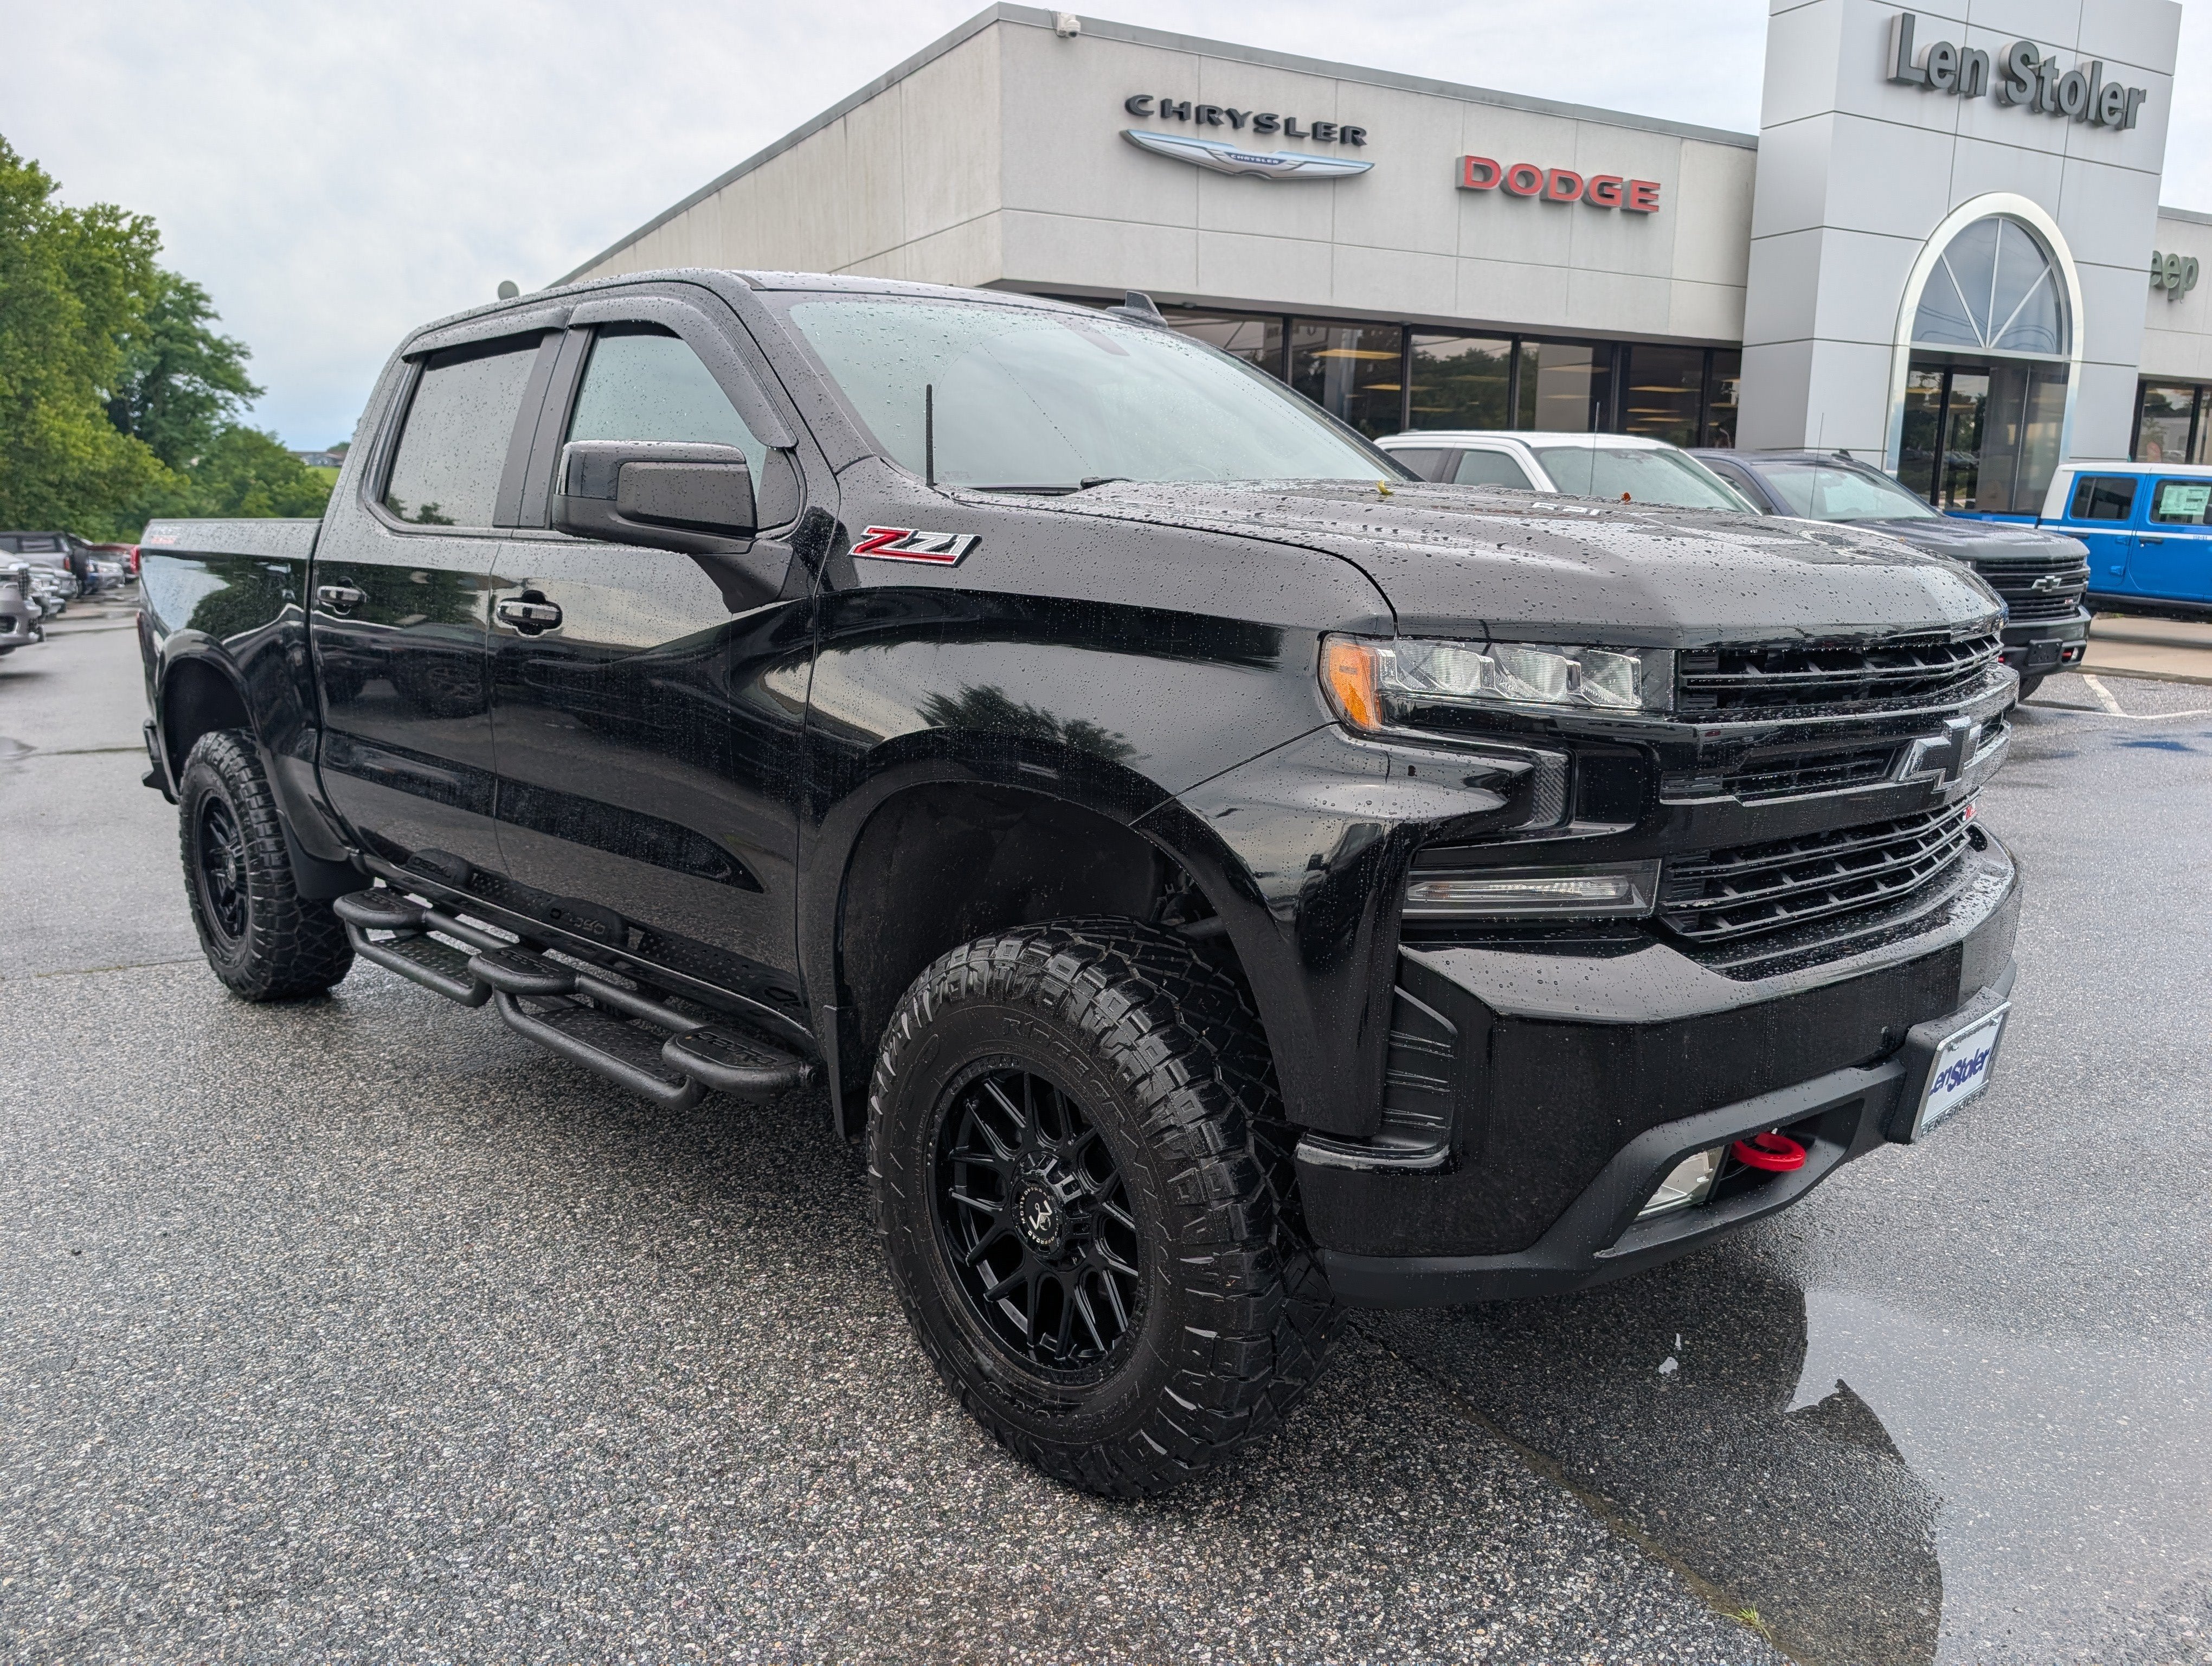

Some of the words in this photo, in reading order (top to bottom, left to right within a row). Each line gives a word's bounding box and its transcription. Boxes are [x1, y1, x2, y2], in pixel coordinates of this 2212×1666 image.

[1887, 12, 1989, 98] Len
[1996, 40, 2146, 130] Stoler
[1125, 94, 1368, 146] CHRYSLER
[1230, 154, 1279, 164] CHRYSLER
[1456, 155, 1661, 213] DODGE
[2150, 250, 2199, 302] eep
[847, 525, 982, 568] Z71
